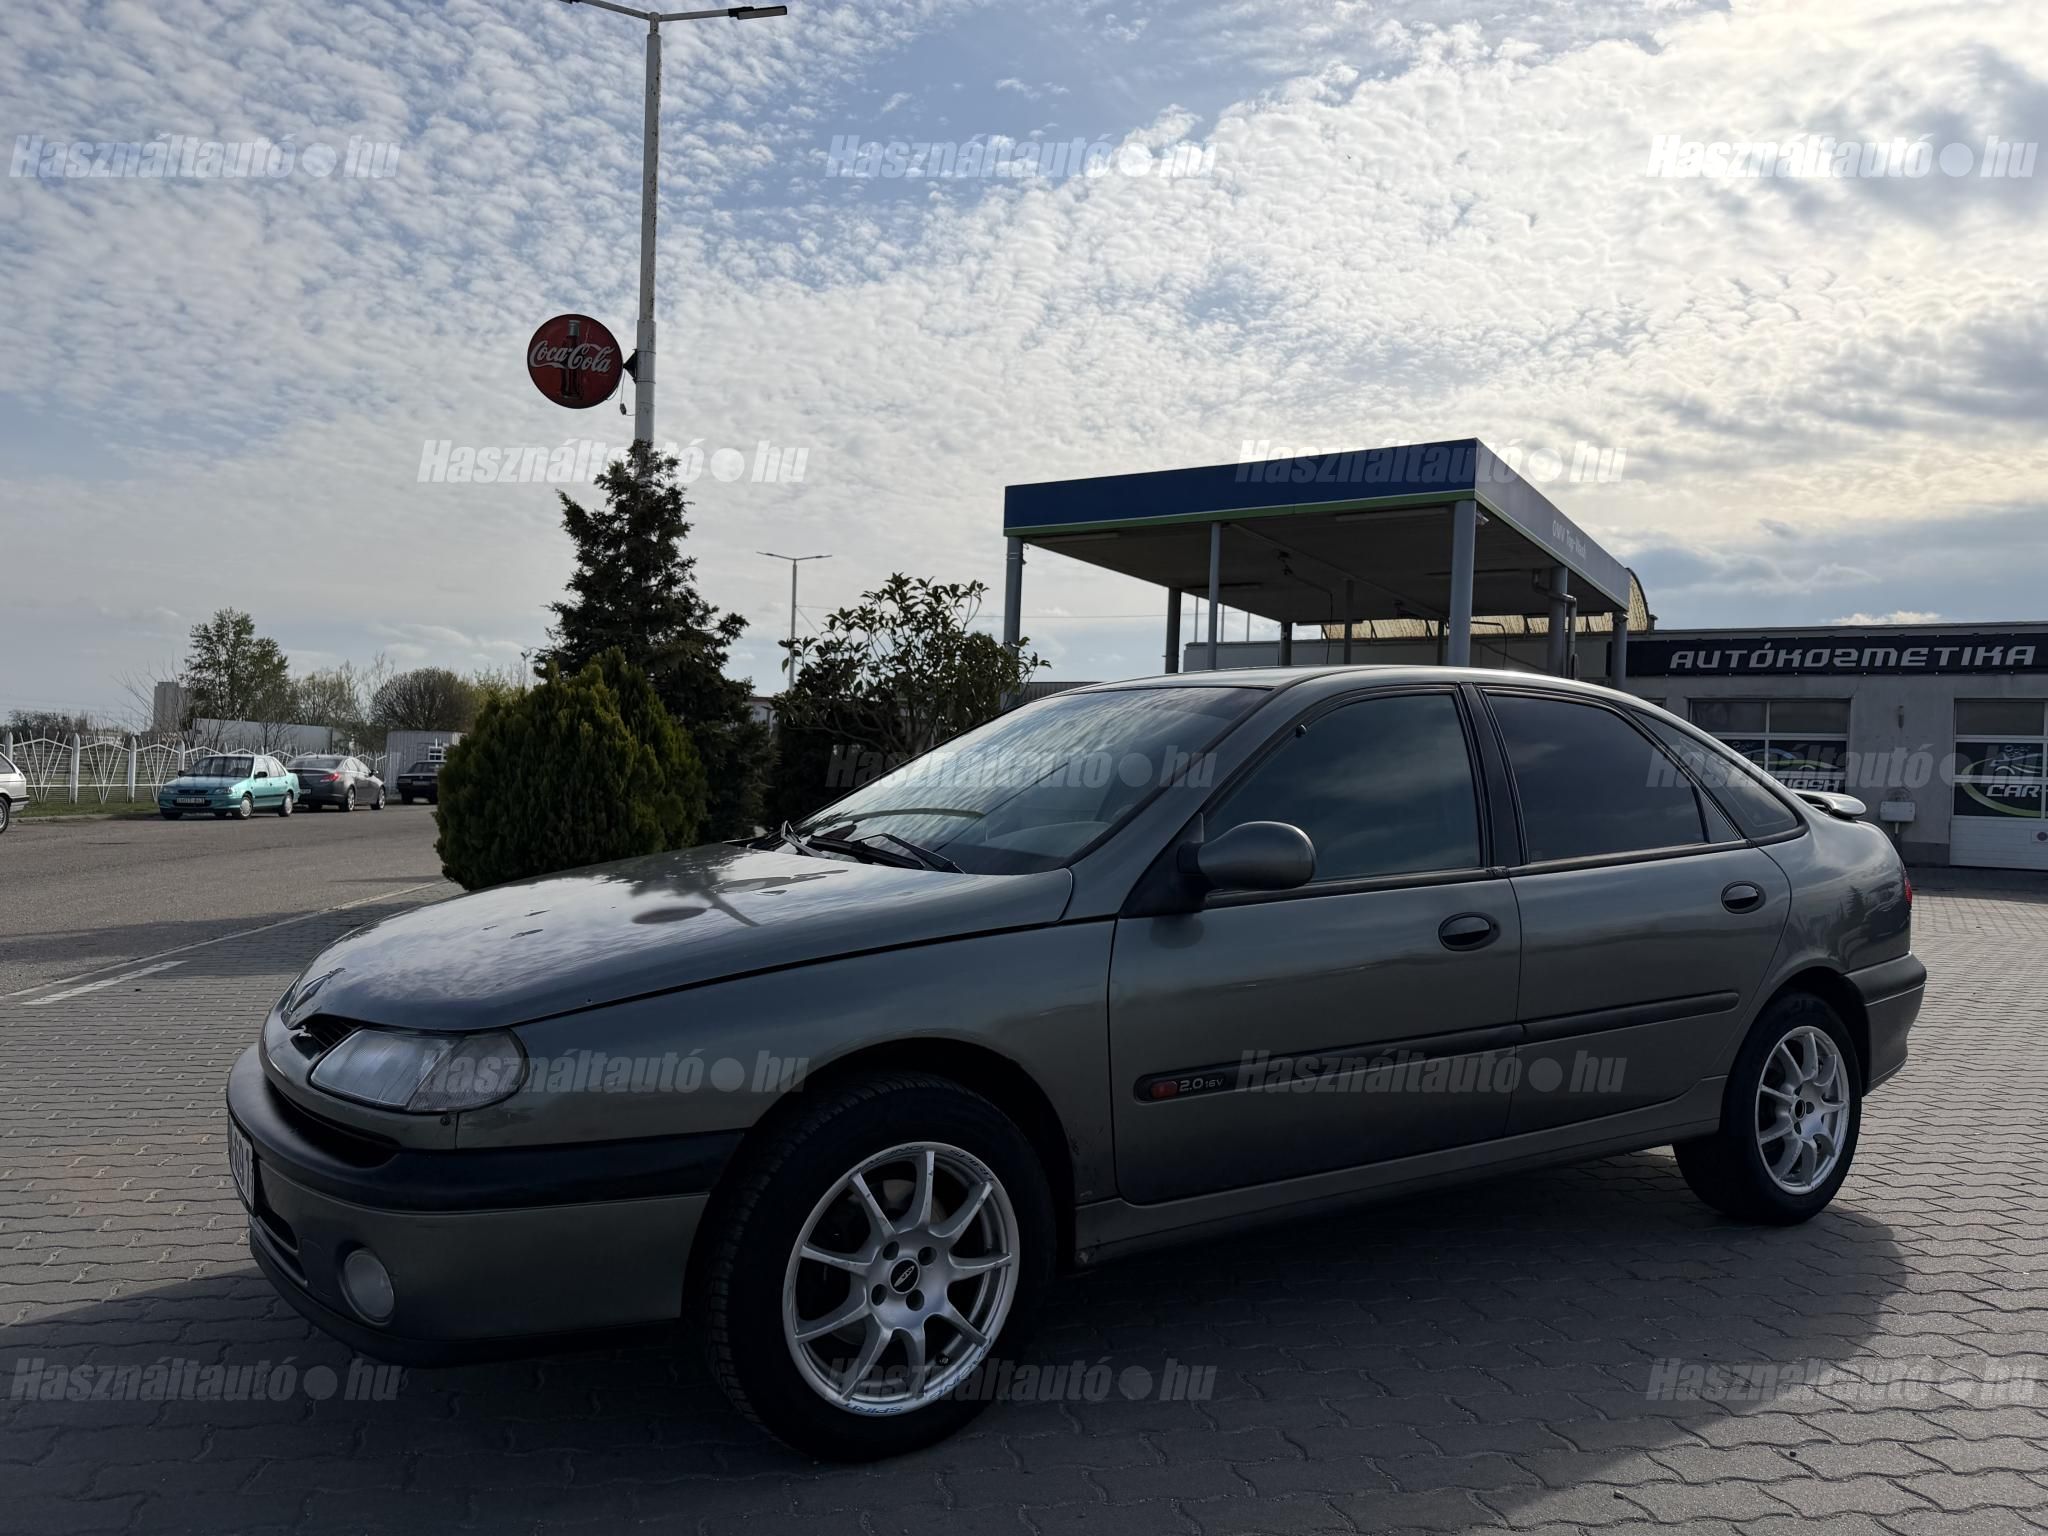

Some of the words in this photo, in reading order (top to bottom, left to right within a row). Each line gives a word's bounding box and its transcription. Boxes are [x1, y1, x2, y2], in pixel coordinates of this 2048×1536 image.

[529, 340, 615, 373] Coca-Cola
[1179, 1077, 1204, 1093] 2.0
[1204, 1078, 1224, 1089] 16V
